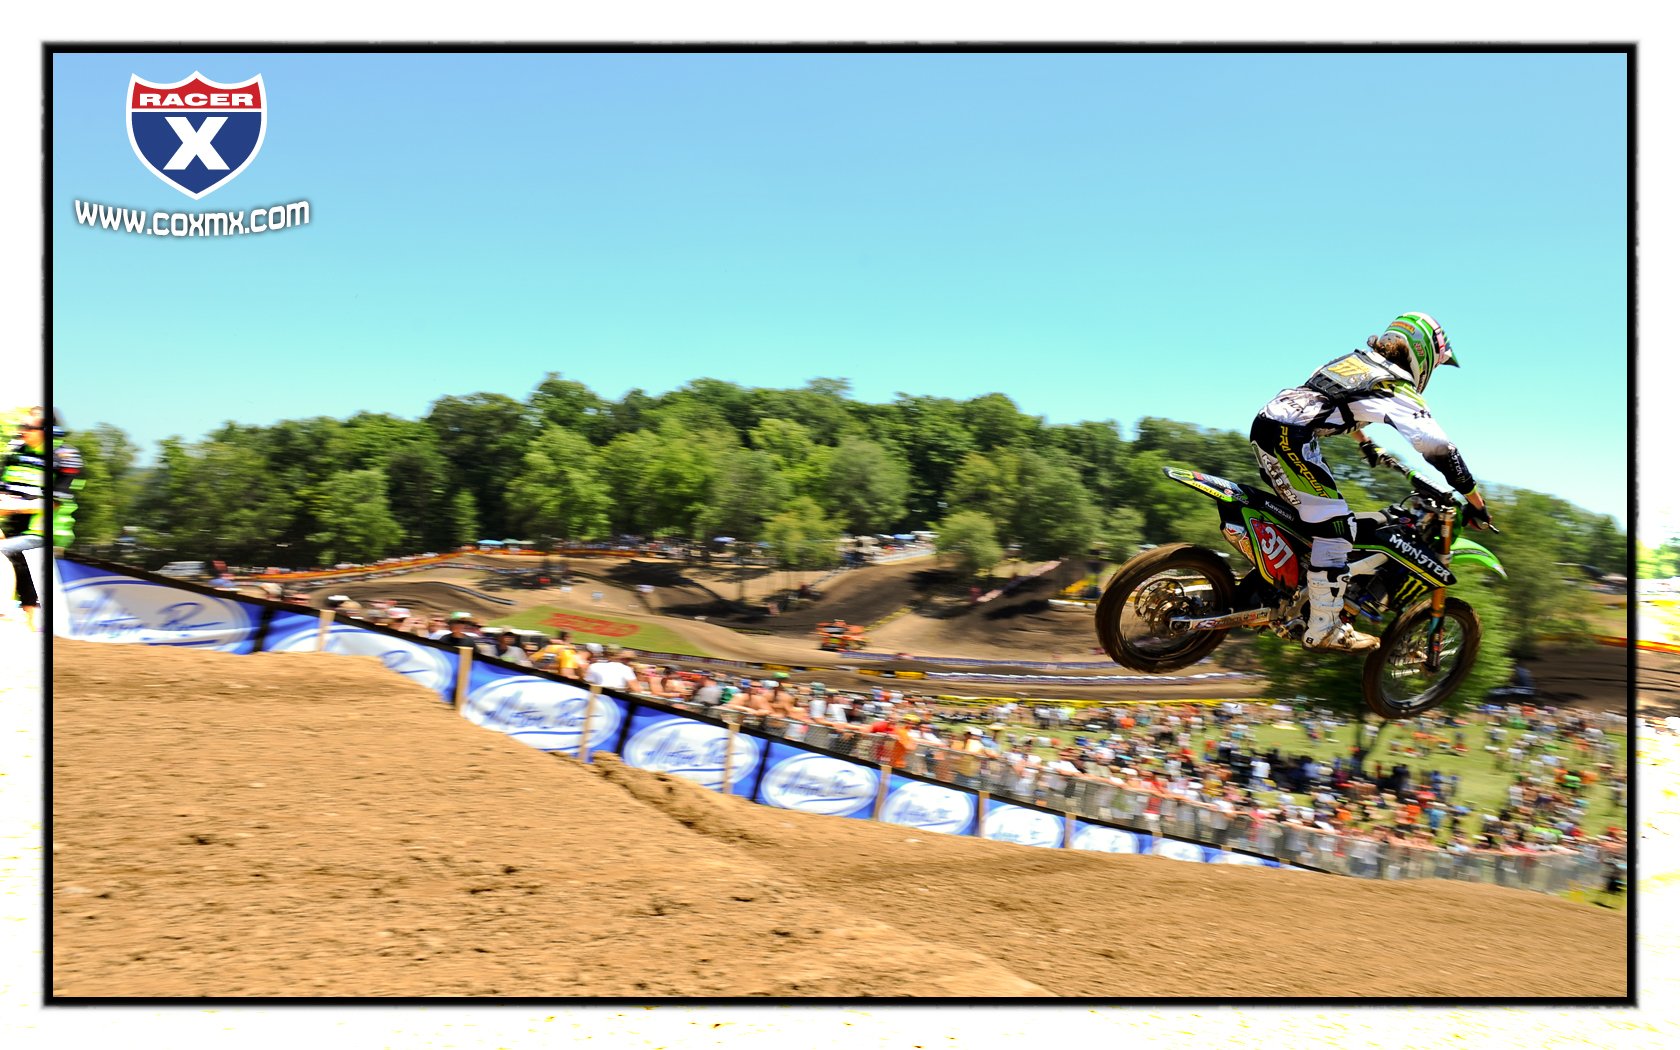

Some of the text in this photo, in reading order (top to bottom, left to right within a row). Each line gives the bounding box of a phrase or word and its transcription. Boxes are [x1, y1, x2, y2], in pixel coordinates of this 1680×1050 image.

[1287, 452, 1330, 499] CIRCUIT
[1261, 526, 1294, 570] 377
[1389, 534, 1451, 582] MONSTER
